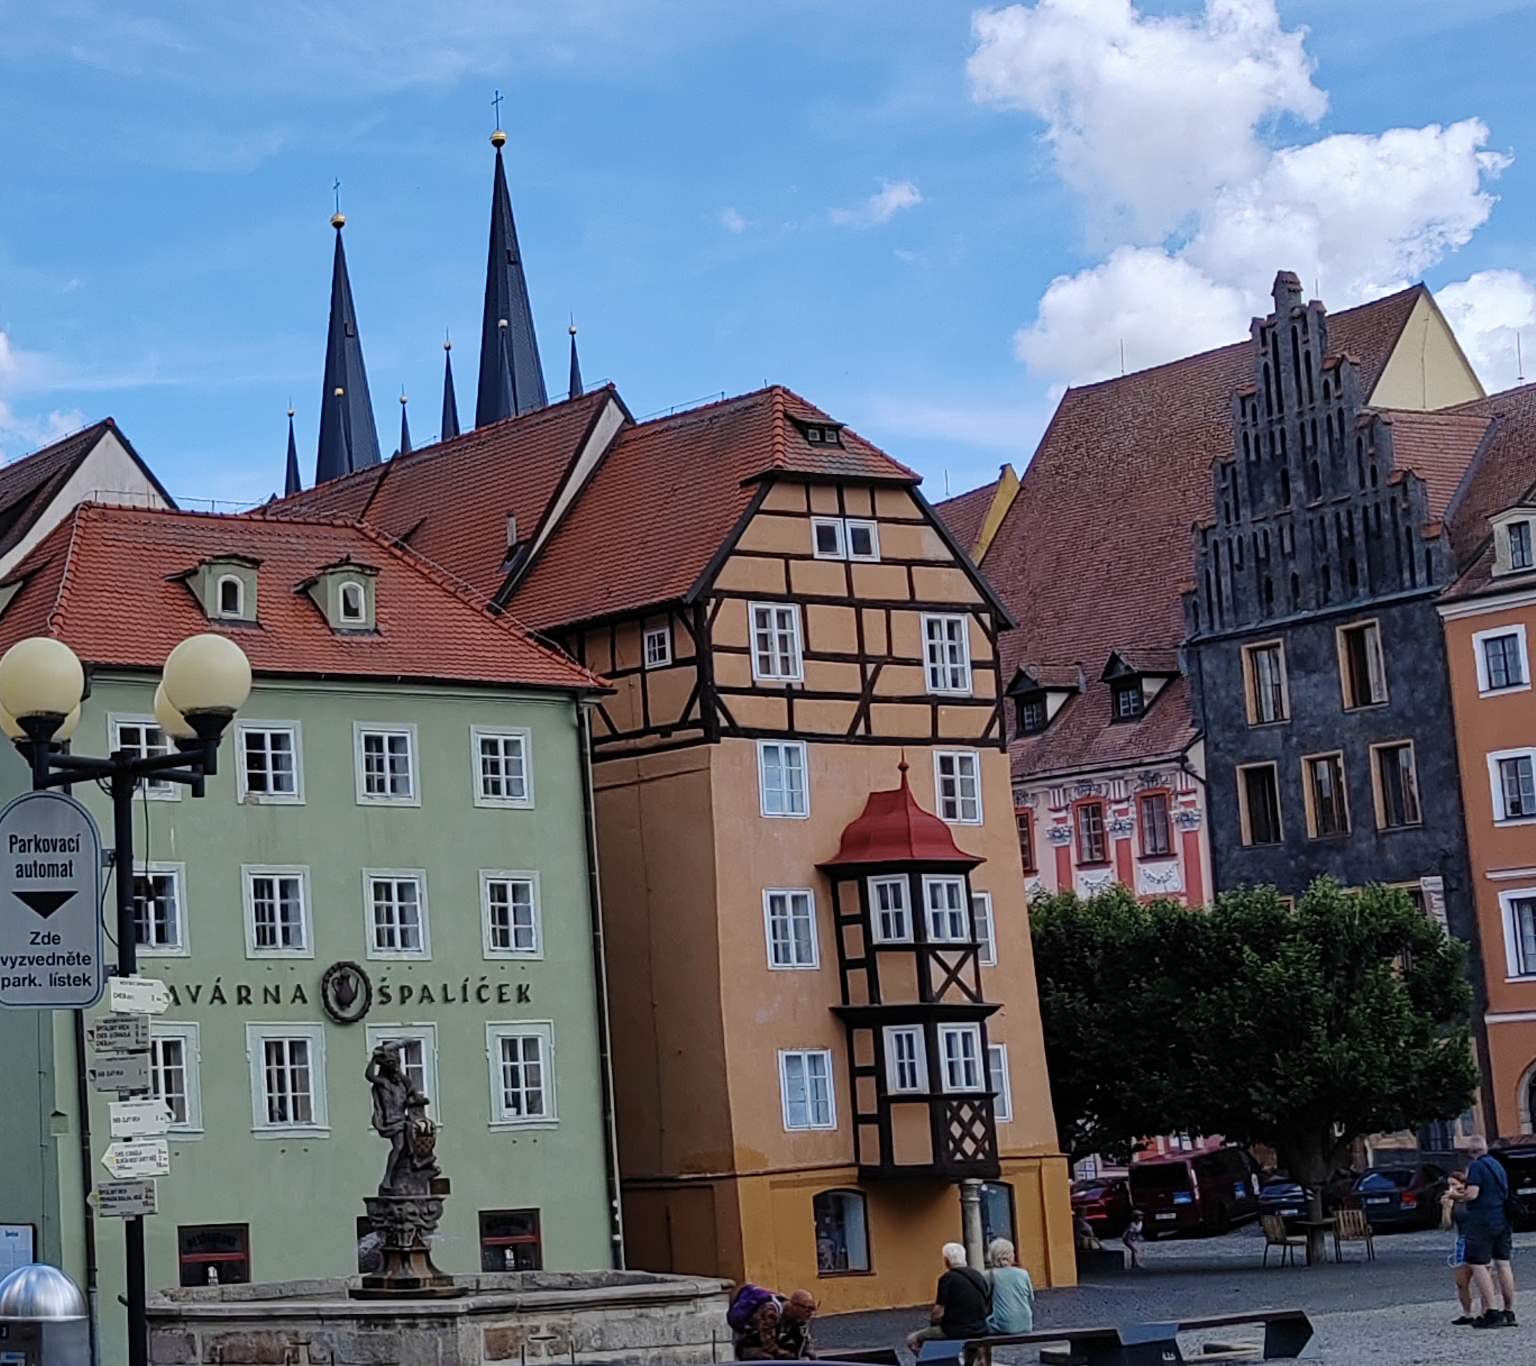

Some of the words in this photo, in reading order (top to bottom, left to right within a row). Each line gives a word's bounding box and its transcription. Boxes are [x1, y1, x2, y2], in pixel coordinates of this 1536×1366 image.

[9, 833, 81, 853] Parkovací
[15, 859, 73, 878] automat
[29, 931, 61, 945] Zde
[0, 951, 92, 970] vyzvedněte
[1, 973, 42, 991] park.
[49, 972, 92, 987] lístek
[378, 976, 532, 1005] ŠPALÍČEK
